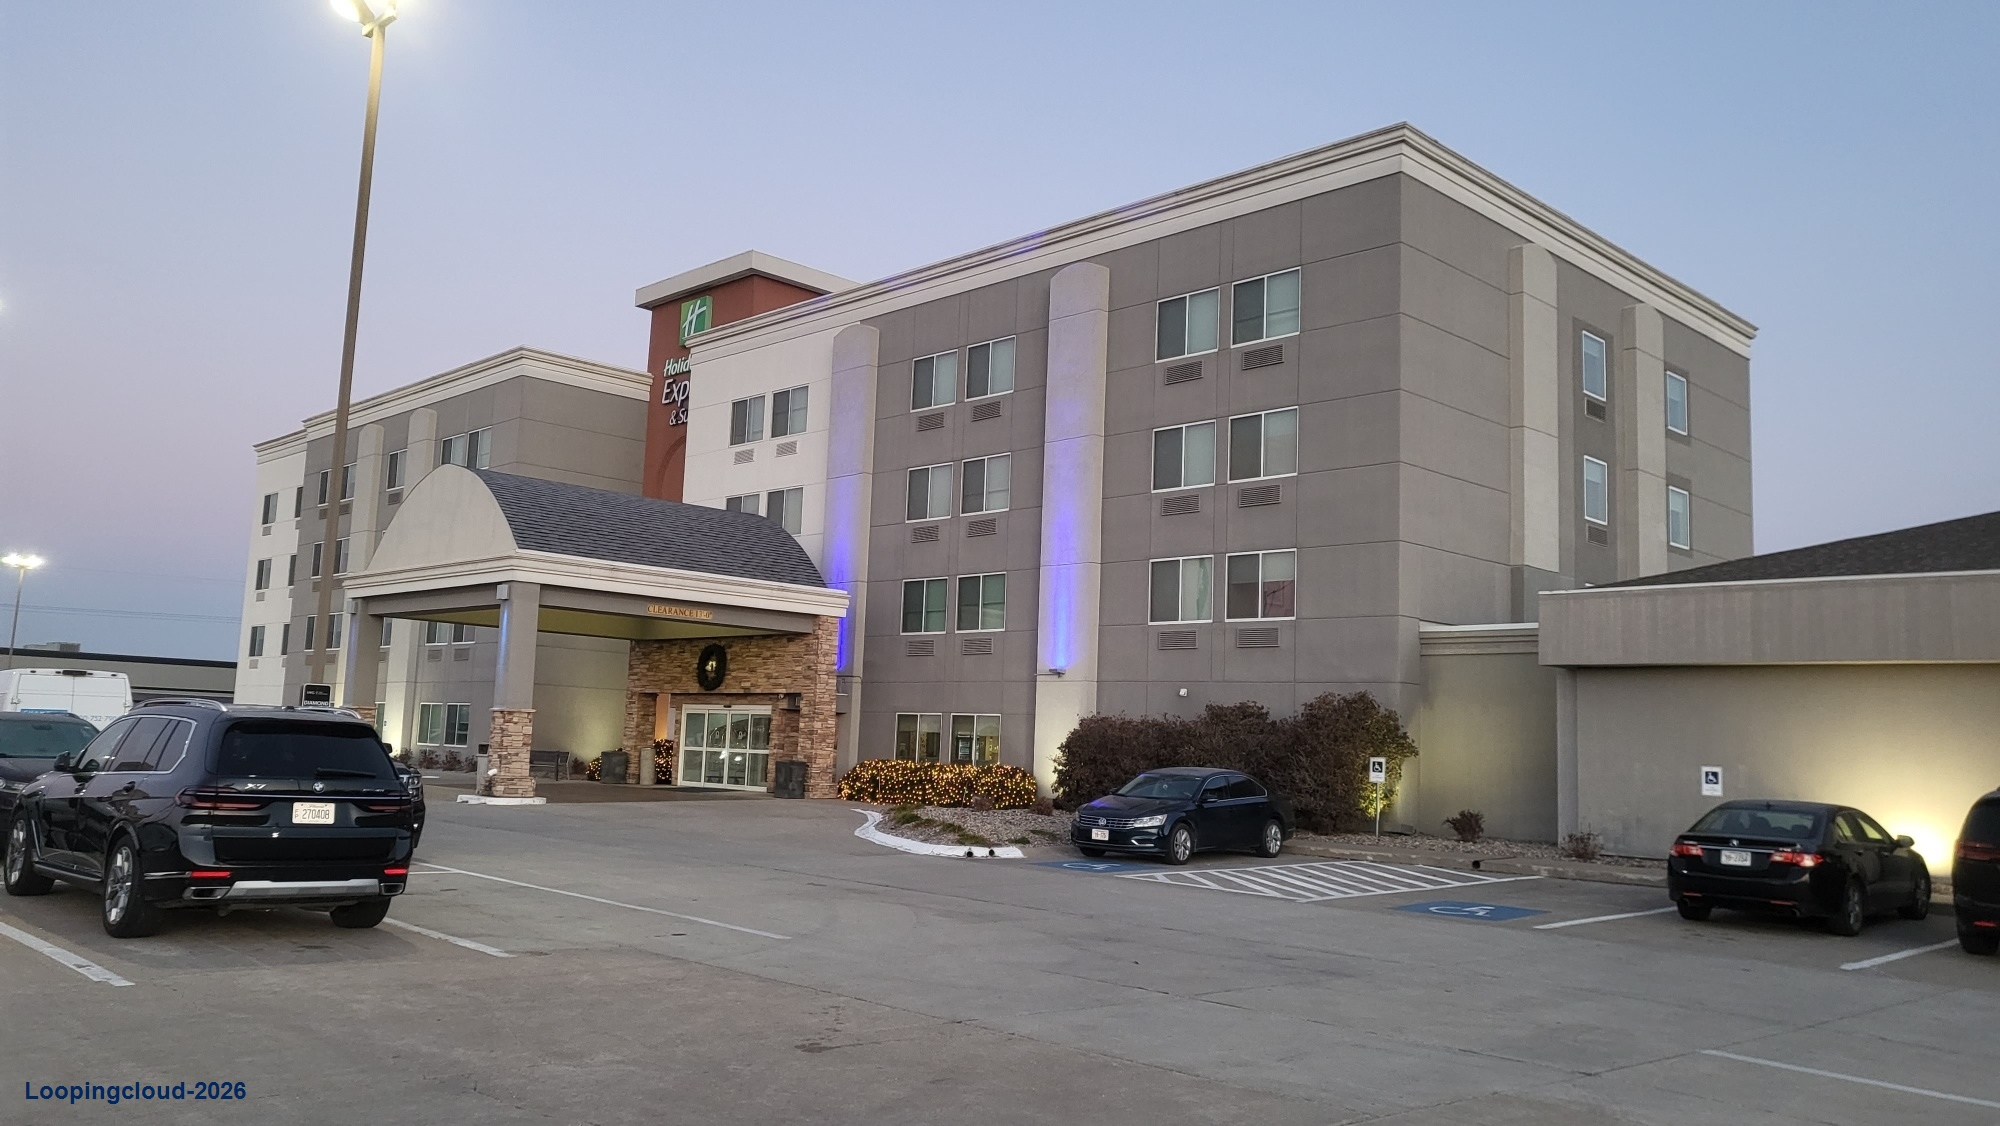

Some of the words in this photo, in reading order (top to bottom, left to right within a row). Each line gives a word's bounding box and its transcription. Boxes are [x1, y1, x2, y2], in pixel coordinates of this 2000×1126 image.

[662, 379, 690, 407] Exp
[670, 410, 676, 425] &
[648, 604, 693, 617] CLEARANCE
[302, 809, 330, 819] 270408
